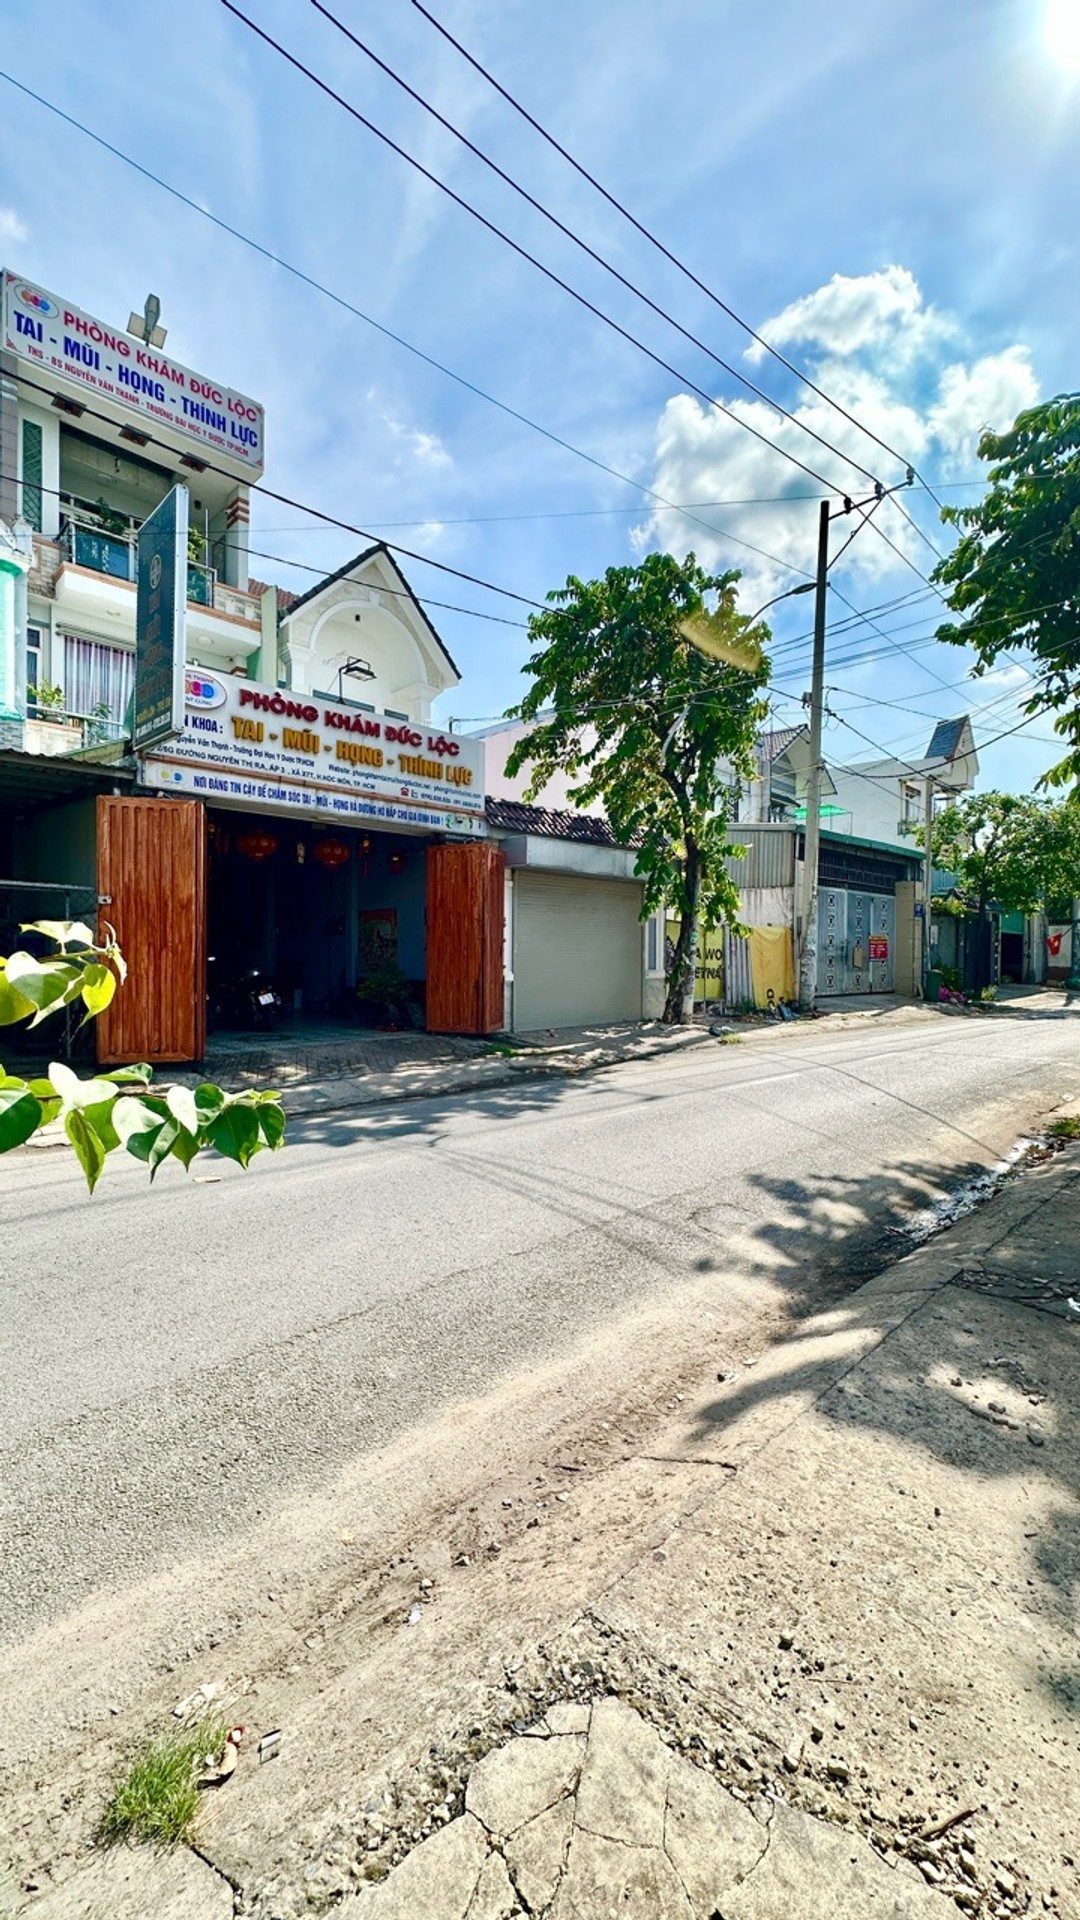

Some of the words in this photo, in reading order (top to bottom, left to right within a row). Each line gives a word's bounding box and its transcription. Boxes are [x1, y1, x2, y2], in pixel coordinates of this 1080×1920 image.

[14, 310, 43, 343] TAI
[64, 336, 100, 370] MŨI
[118, 364, 164, 402] HỌNG
[181, 396, 226, 432] THÍNH
[231, 422, 258, 447] LỰC
[52, 356, 62, 368] BS
[64, 310, 130, 356] PHÒNG
[136, 350, 184, 386] KHÁM
[190, 378, 222, 404] ĐỨC
[228, 398, 258, 422] LỘC
[176, 734, 196, 744] guyễn
[231, 716, 264, 743] TAI
[283, 728, 320, 754] MŨI
[336, 740, 384, 767] HỌNG
[398, 753, 444, 780] THÍNH
[446, 764, 474, 787] LỰC
[239, 688, 318, 722] PHÒNG
[324, 710, 380, 738] KHÁM
[384, 725, 422, 747] ĐỨC
[428, 735, 460, 756] LỘC
[230, 782, 242, 794] TIN
